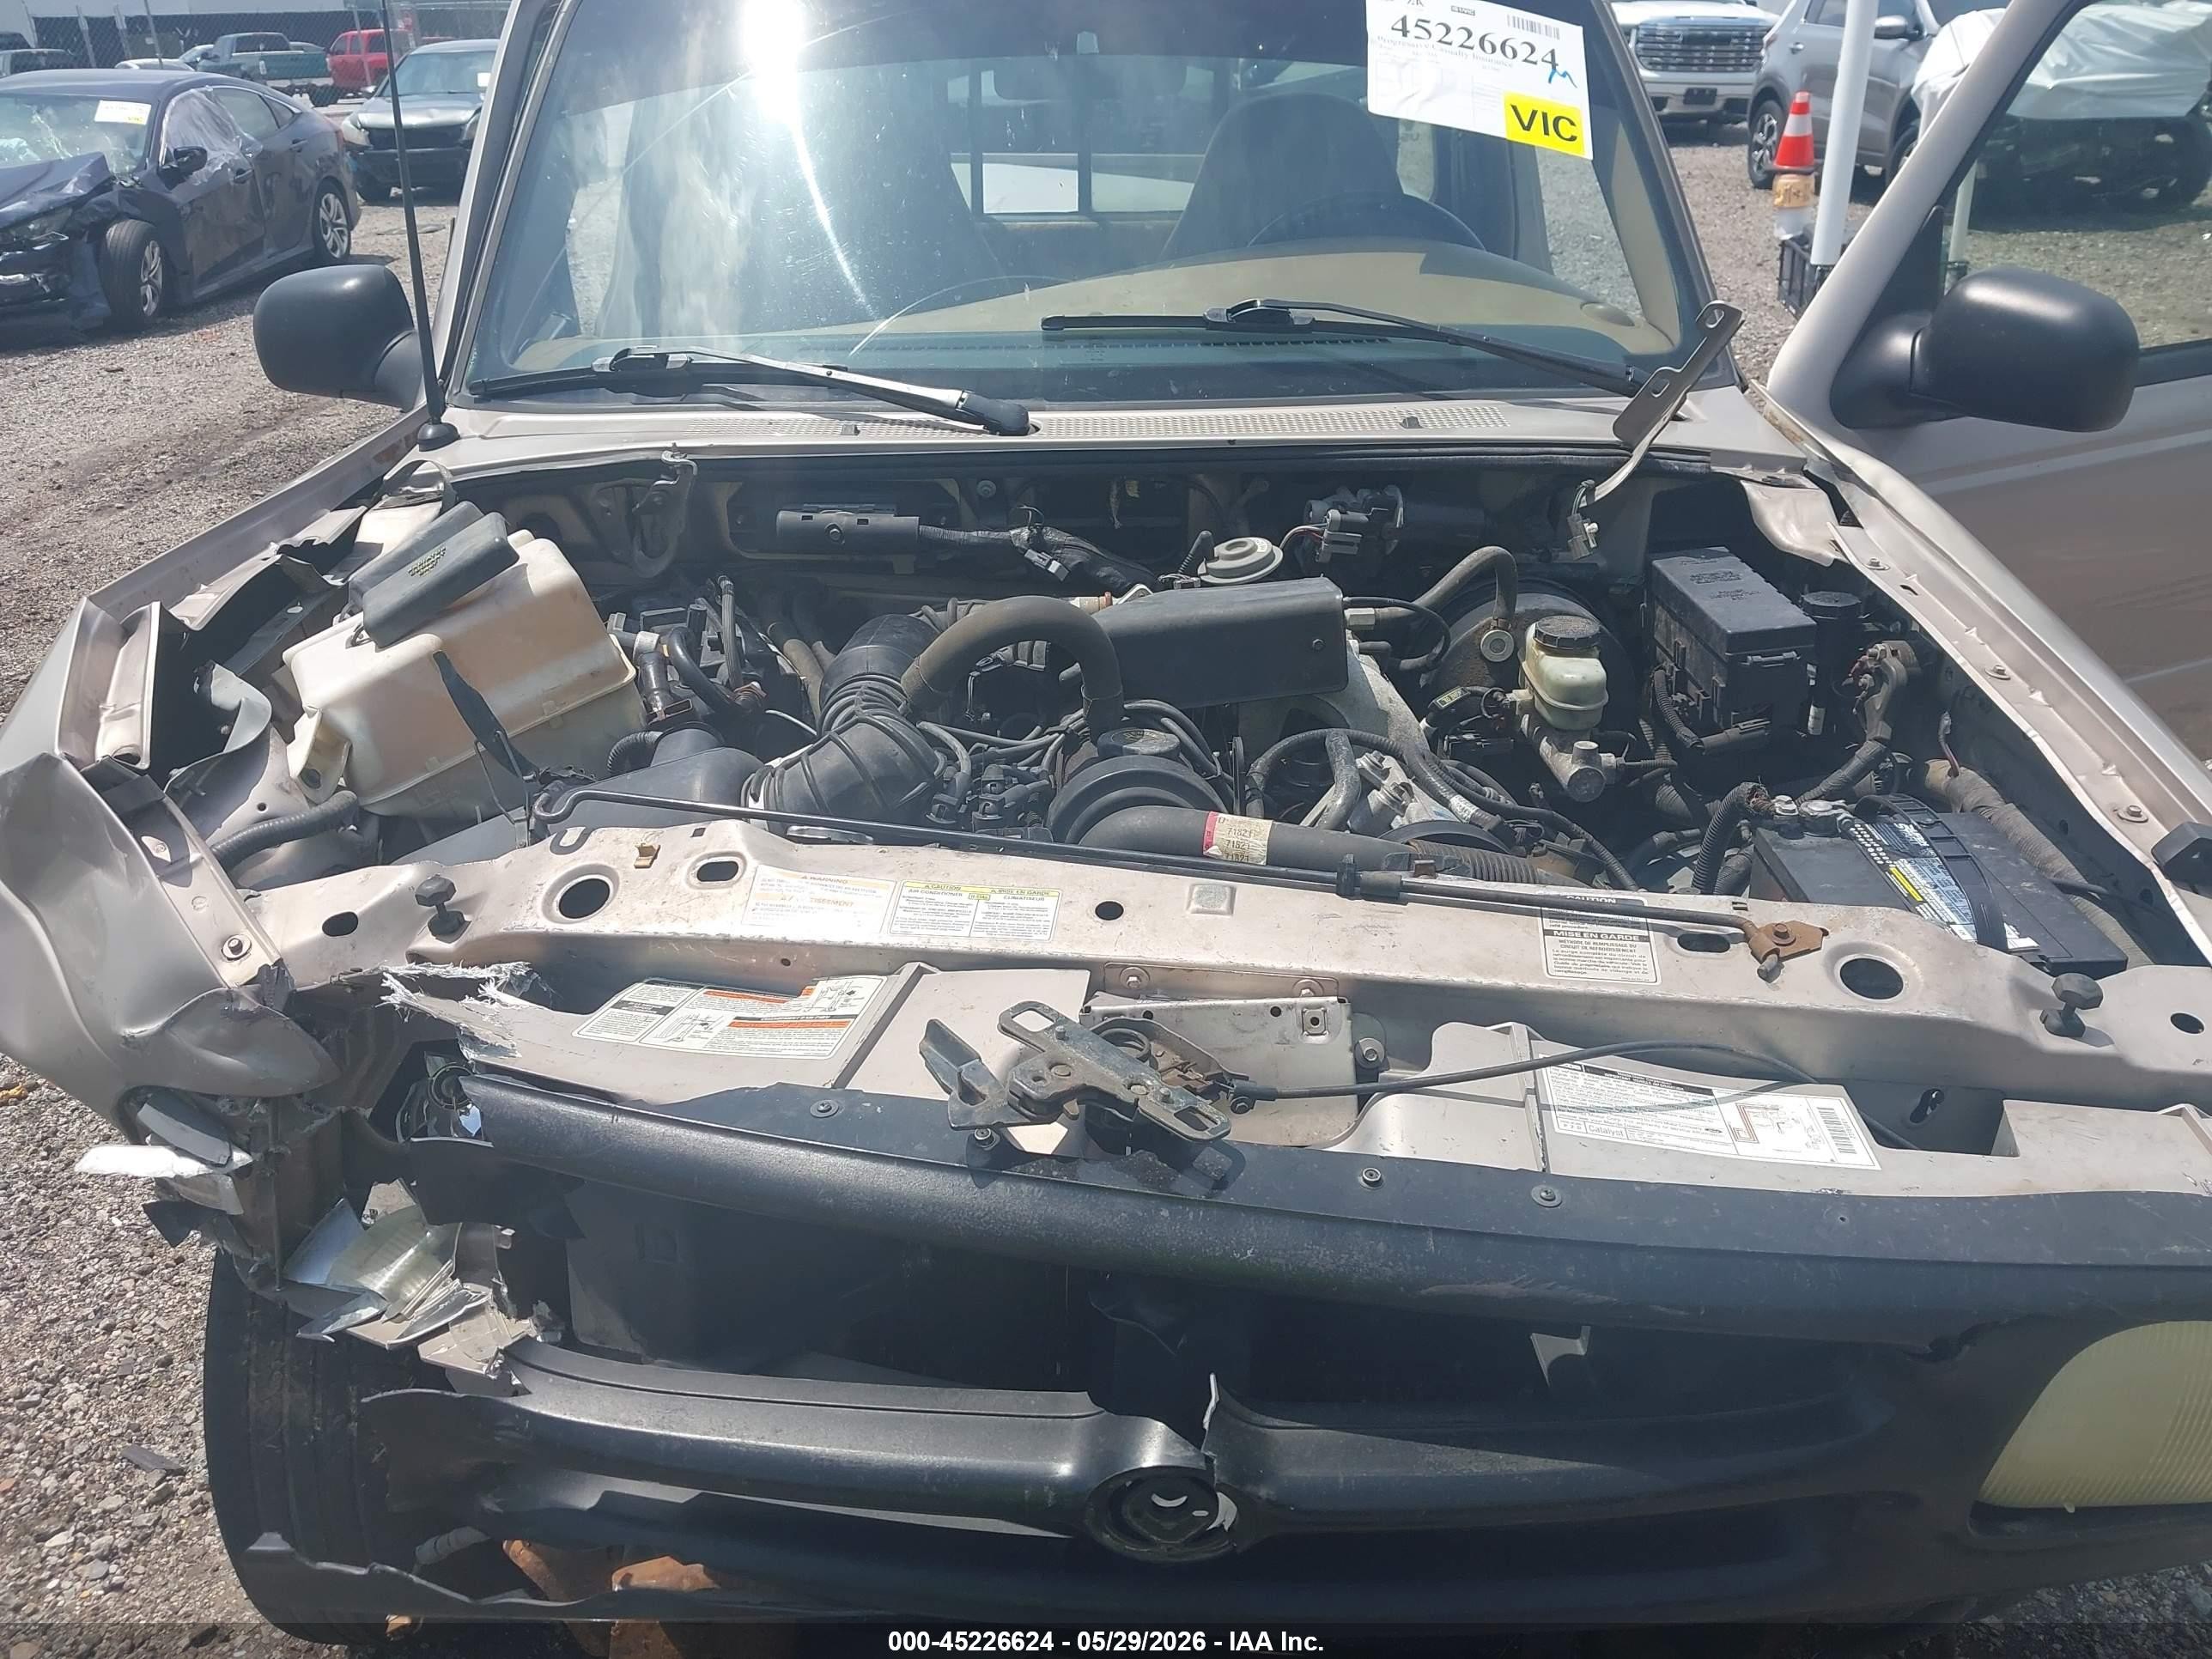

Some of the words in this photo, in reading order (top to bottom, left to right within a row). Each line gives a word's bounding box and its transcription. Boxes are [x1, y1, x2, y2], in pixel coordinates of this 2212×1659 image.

[1391, 14, 1559, 70] 45226624
[1510, 104, 1578, 142] VIC
[1601, 933, 1639, 941] GARDE
[1589, 1124, 1624, 1137] Catalyst
